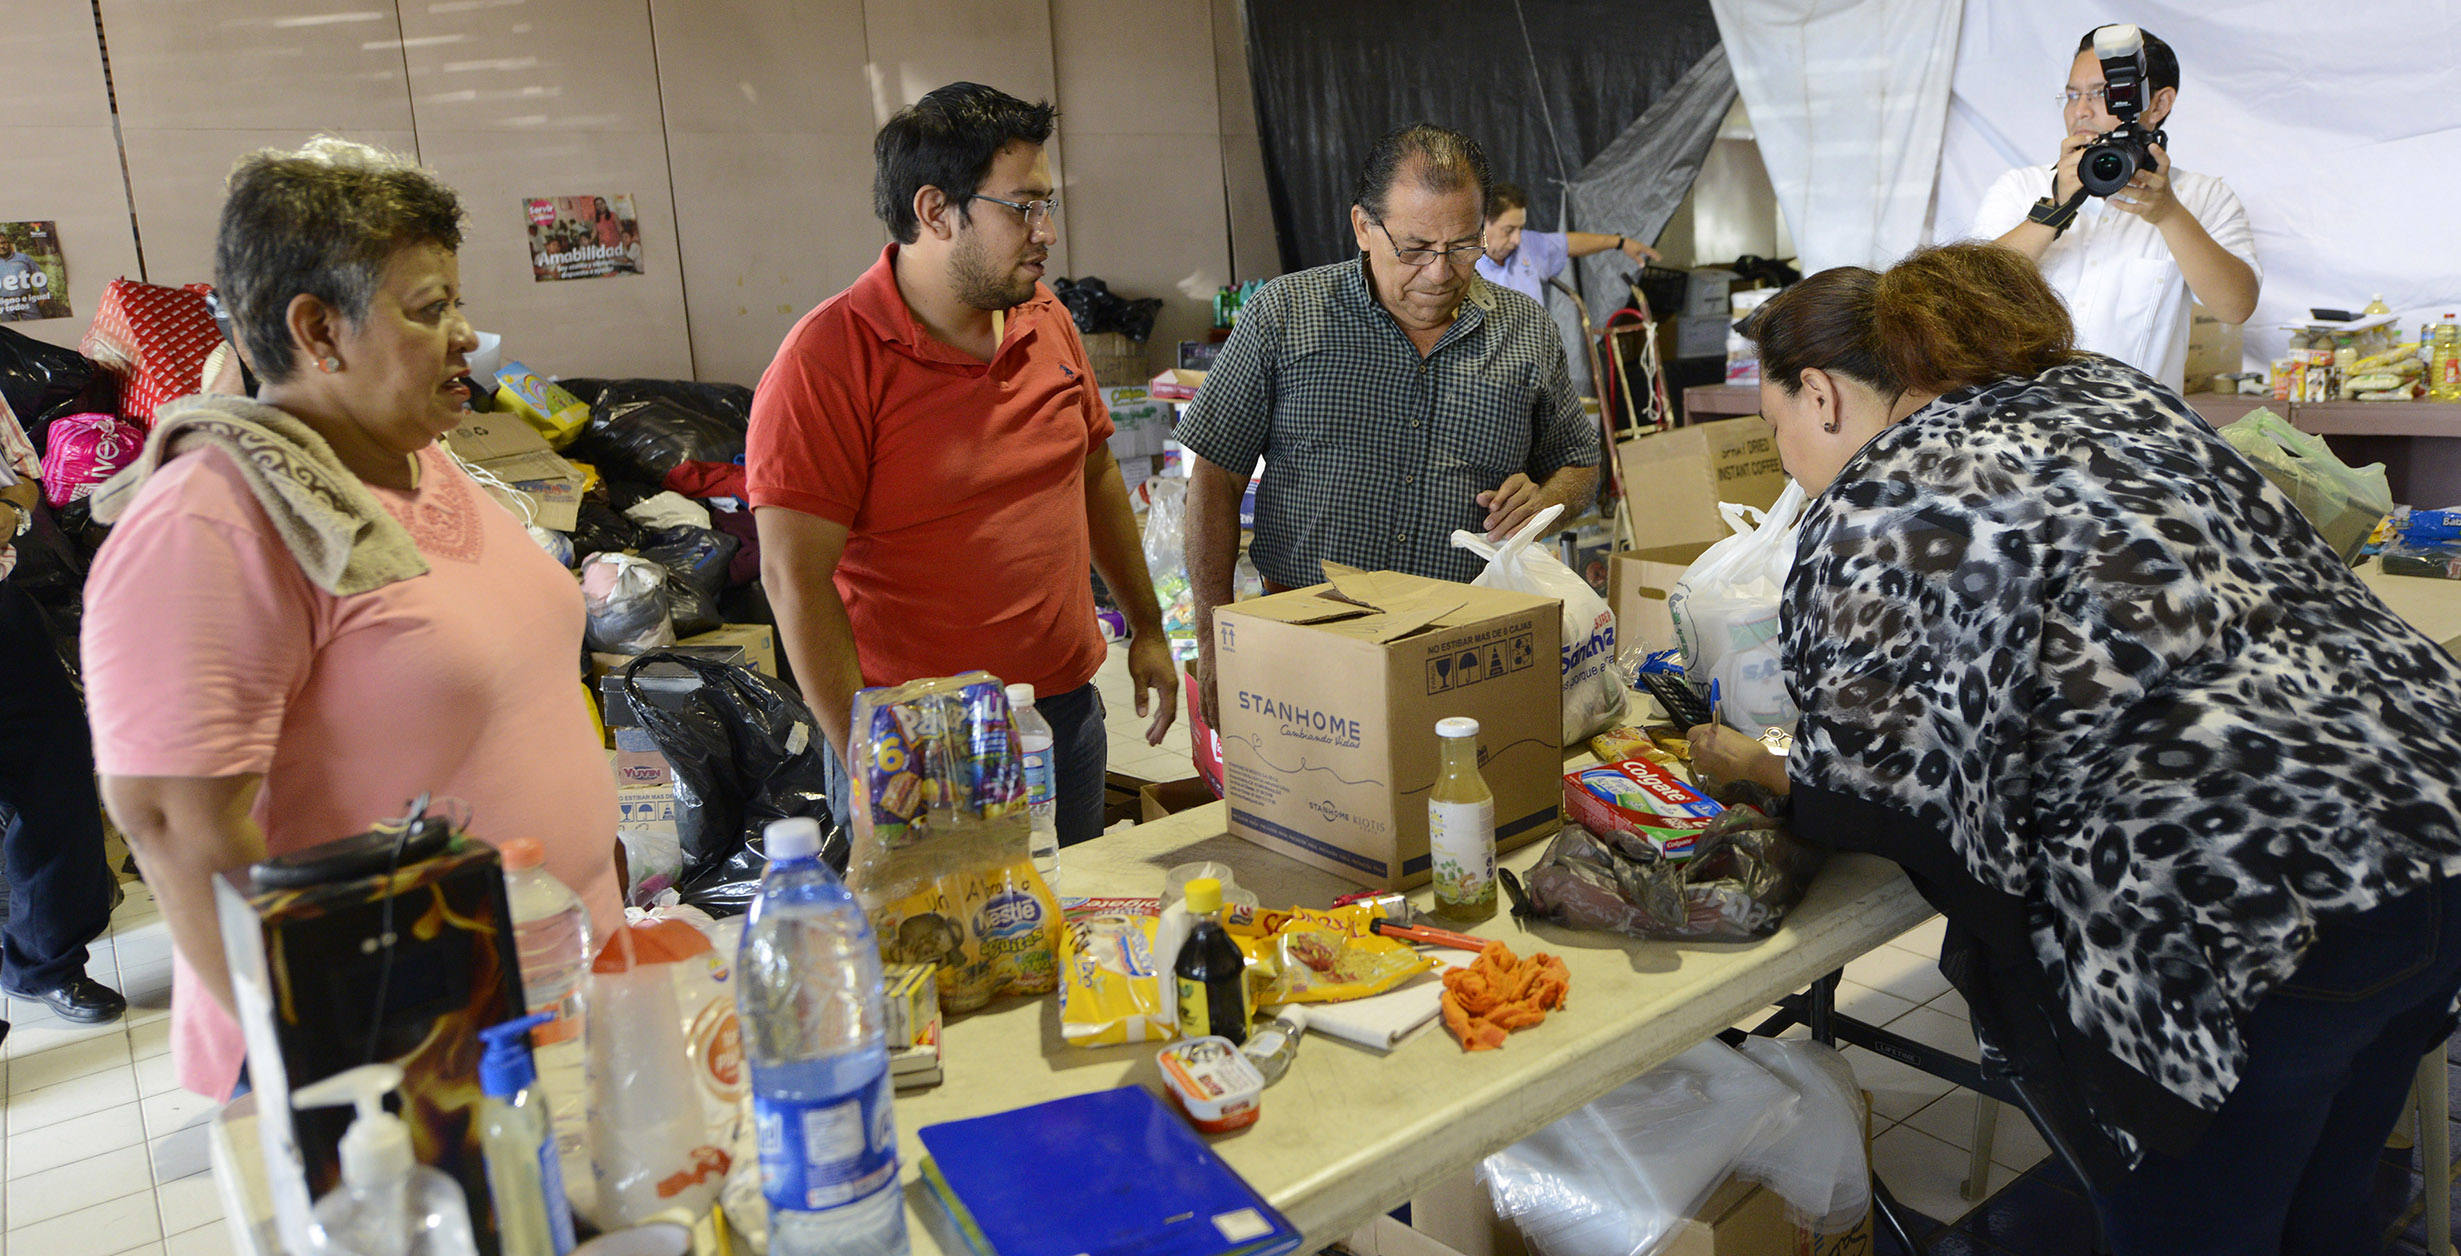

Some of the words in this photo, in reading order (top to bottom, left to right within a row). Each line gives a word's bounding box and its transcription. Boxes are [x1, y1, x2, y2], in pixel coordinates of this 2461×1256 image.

[538, 242, 623, 266] Amabilidad
[0, 270, 47, 291] eto
[6, 303, 30, 312] todos
[28, 292, 50, 302] igual
[1747, 438, 1769, 454] DRIED
[1717, 462, 1749, 480] INSTANT
[1751, 458, 1779, 475] COFFEE
[1428, 645, 1439, 654] NO
[1441, 637, 1473, 652] ESTIBAR
[1475, 632, 1490, 643] MAS
[1492, 629, 1502, 639] DE
[1510, 621, 1532, 634] CAJAS
[1239, 691, 1361, 741] STANHOME
[1280, 724, 1333, 744] Cambiando
[1335, 737, 1360, 749] Vidas
[878, 736, 904, 773] 6
[1623, 761, 1687, 801] Colgate
[1309, 801, 1350, 821] STANHOME
[1667, 839, 1693, 849] Colgate
[1086, 900, 1160, 909] olgate
